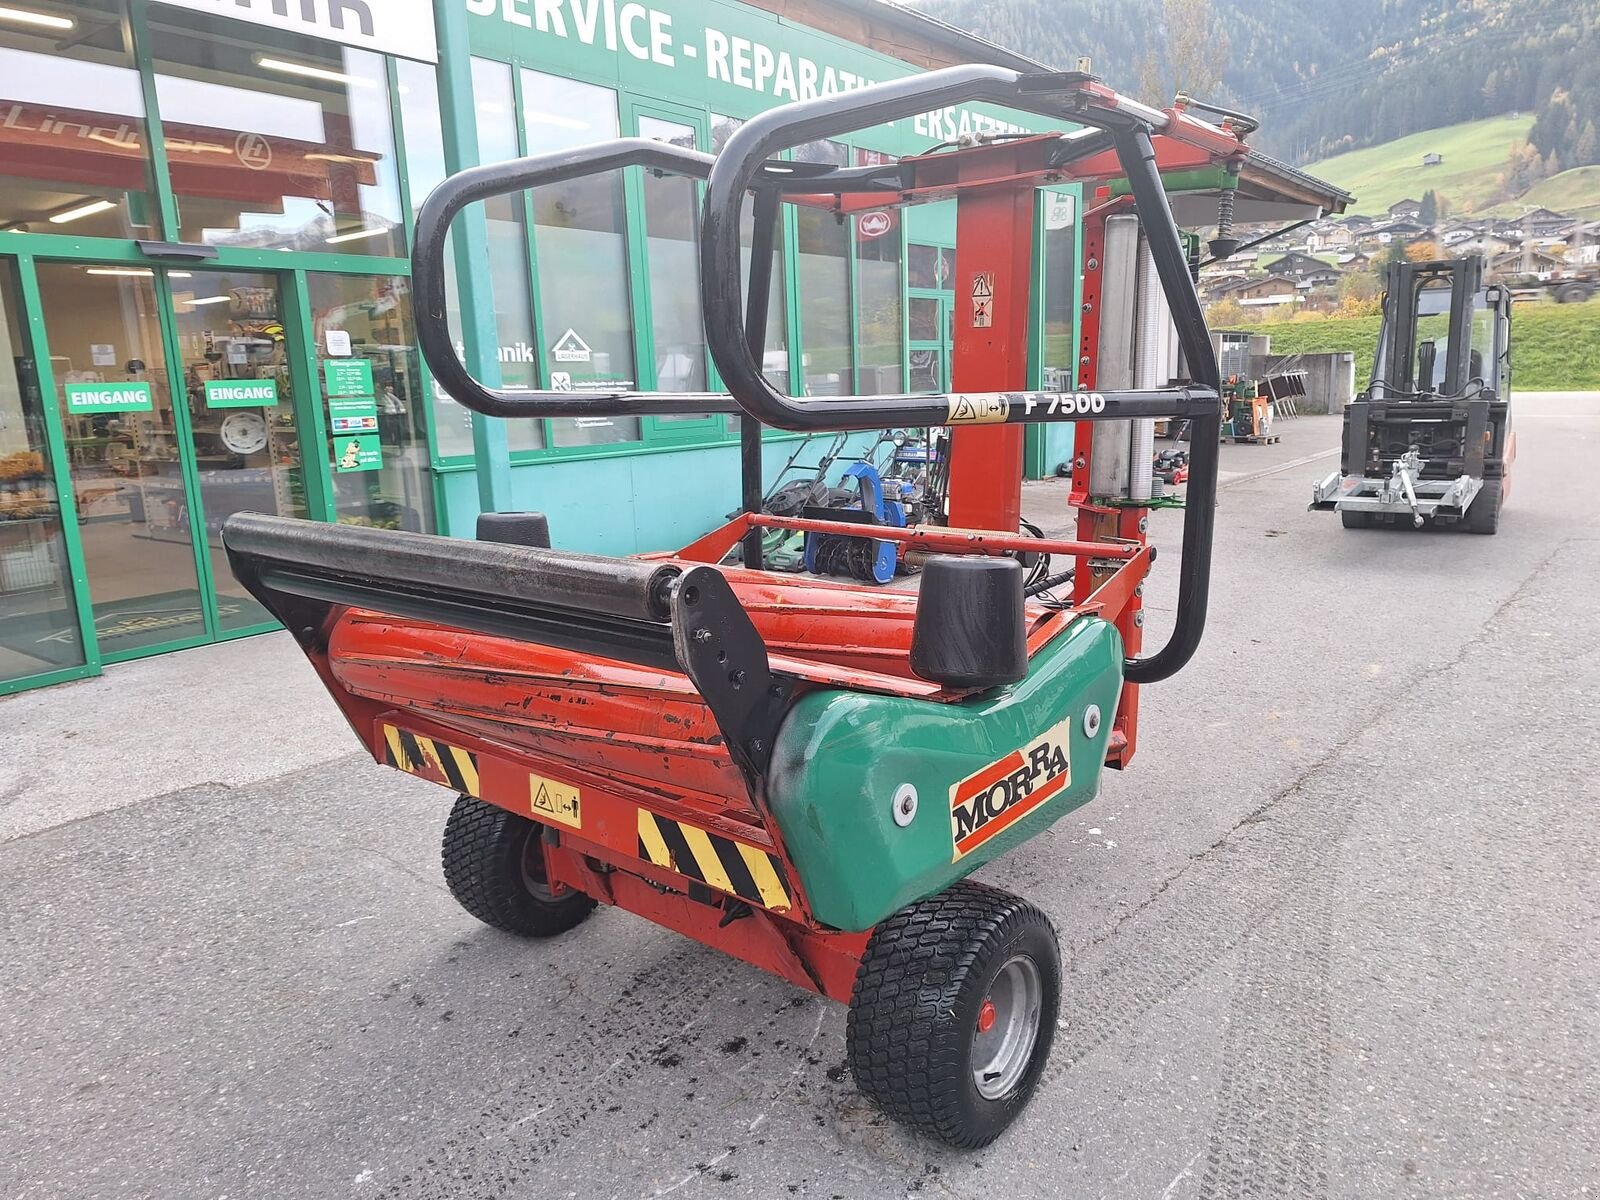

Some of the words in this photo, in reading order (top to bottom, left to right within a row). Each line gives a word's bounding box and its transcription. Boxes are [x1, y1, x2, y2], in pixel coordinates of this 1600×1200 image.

[3, 105, 225, 154] Linder
[71, 390, 147, 405] EINGANG
[209, 387, 273, 400] EINGANG
[1023, 394, 1038, 415] F
[1043, 393, 1105, 414] 7500
[952, 742, 1069, 843] MORRA
